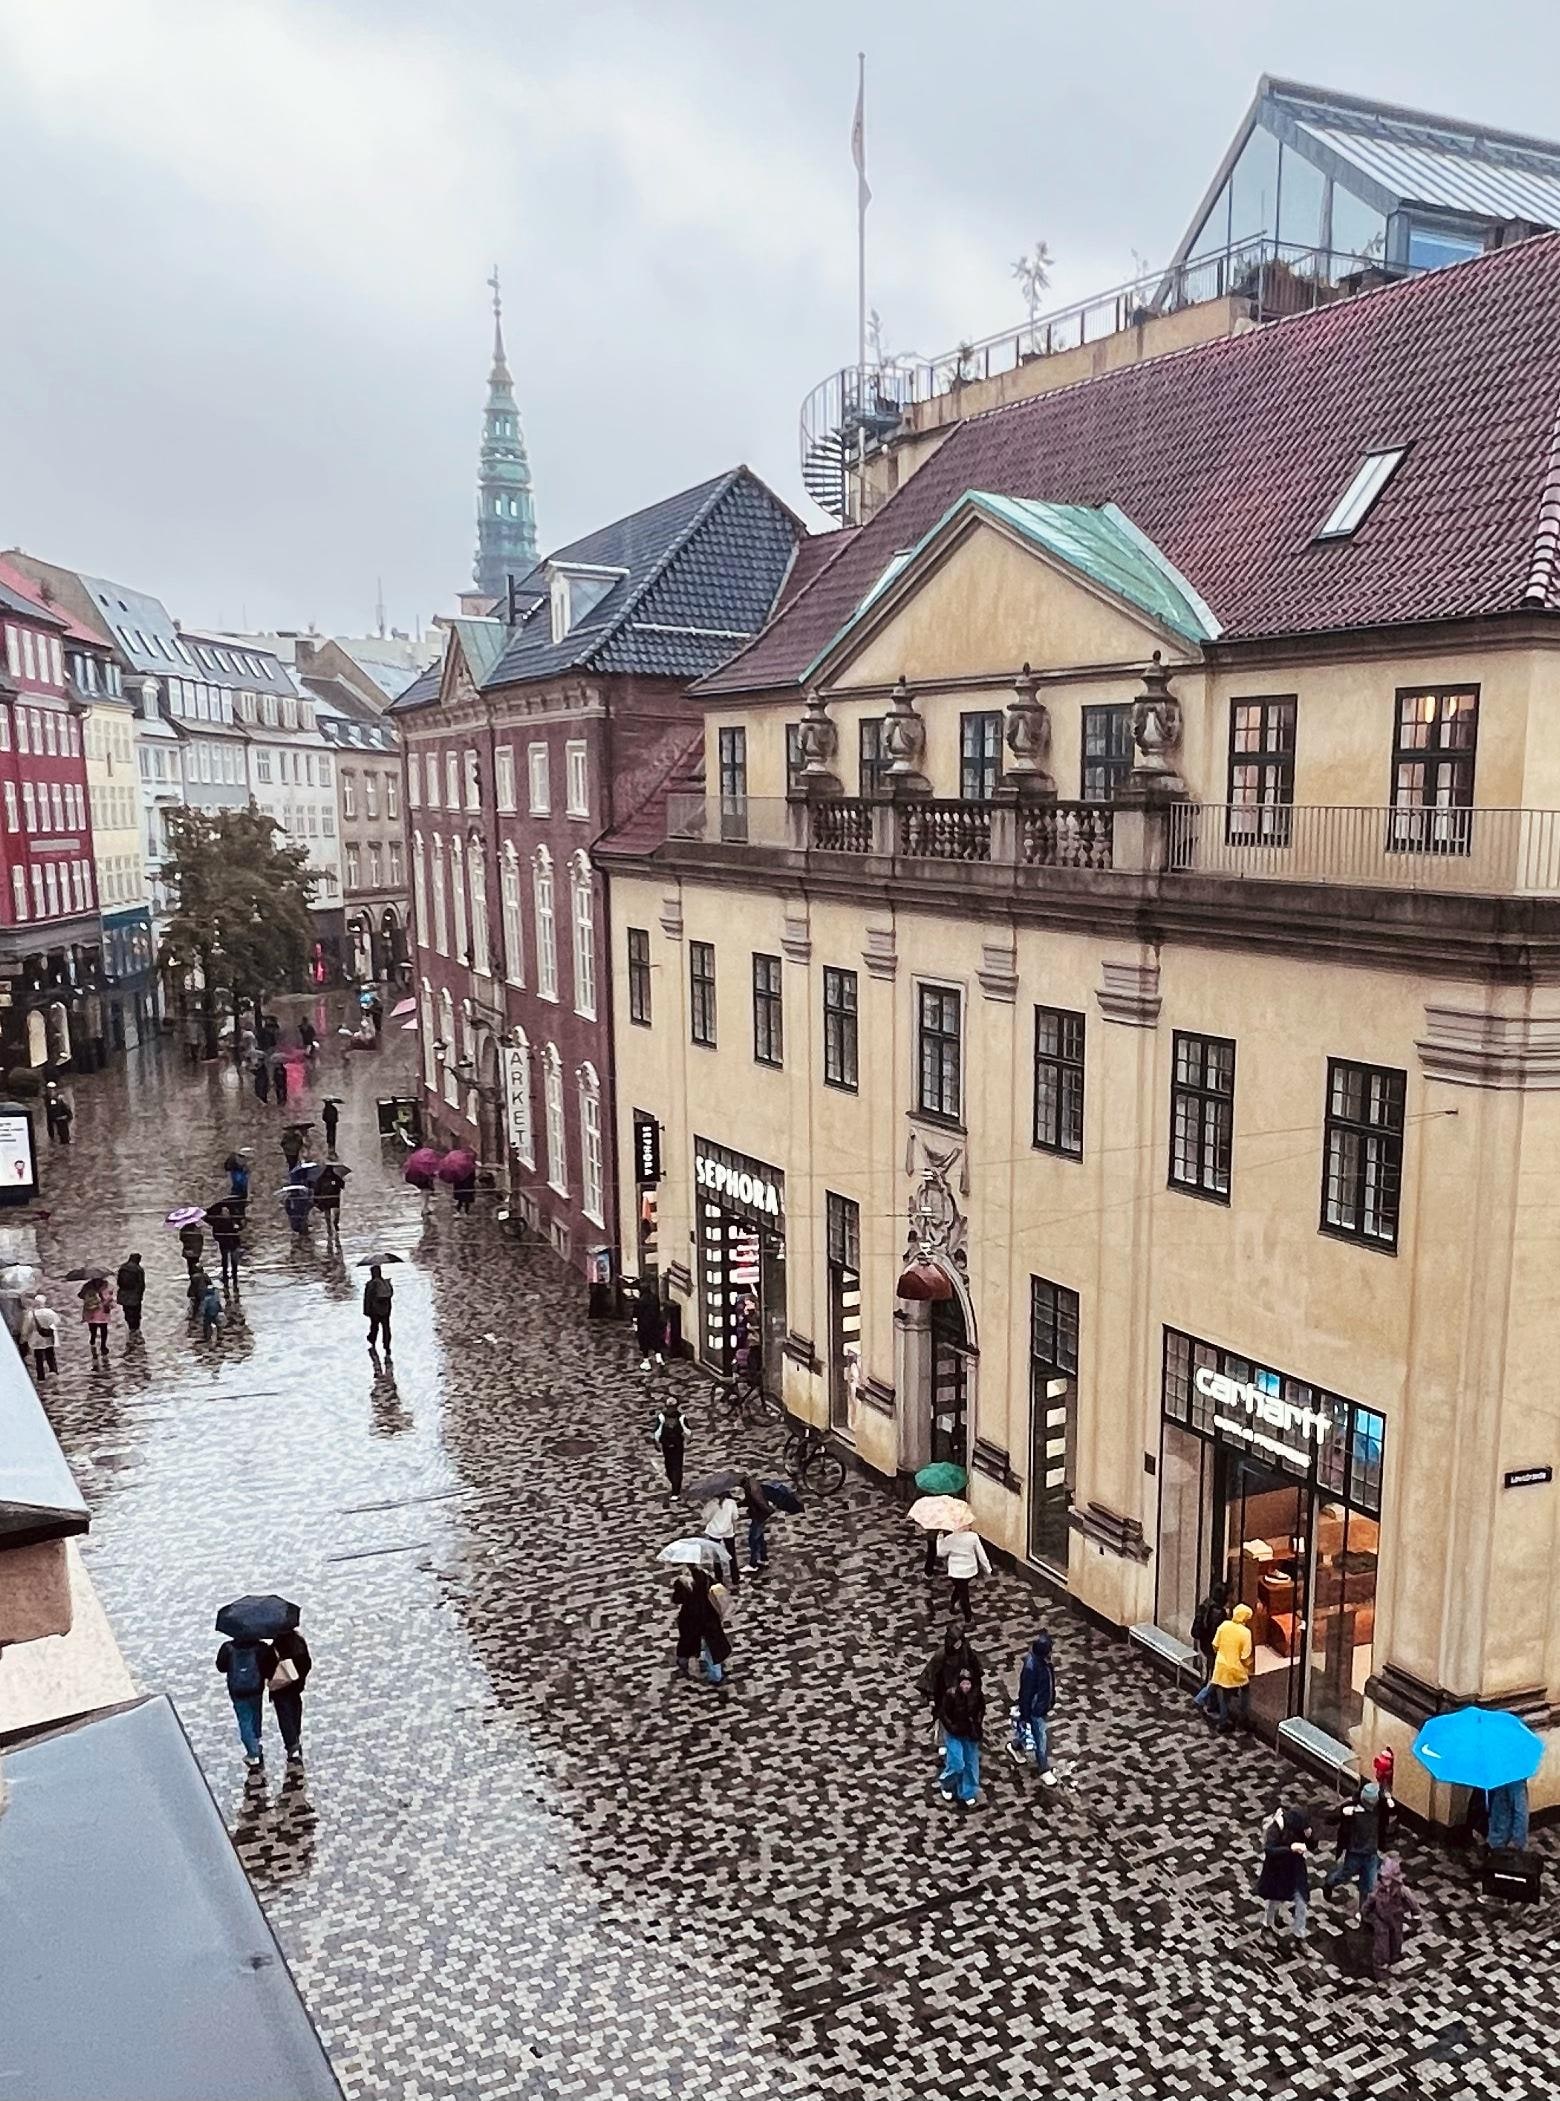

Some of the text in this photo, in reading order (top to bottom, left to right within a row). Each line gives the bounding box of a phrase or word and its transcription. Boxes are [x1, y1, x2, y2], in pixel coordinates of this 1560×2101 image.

[510, 1051, 527, 1145] ARKET
[641, 1126, 654, 1176] SEPHORA
[695, 1155, 779, 1216] SEPHORA
[1195, 1367, 1333, 1445] carhartt
